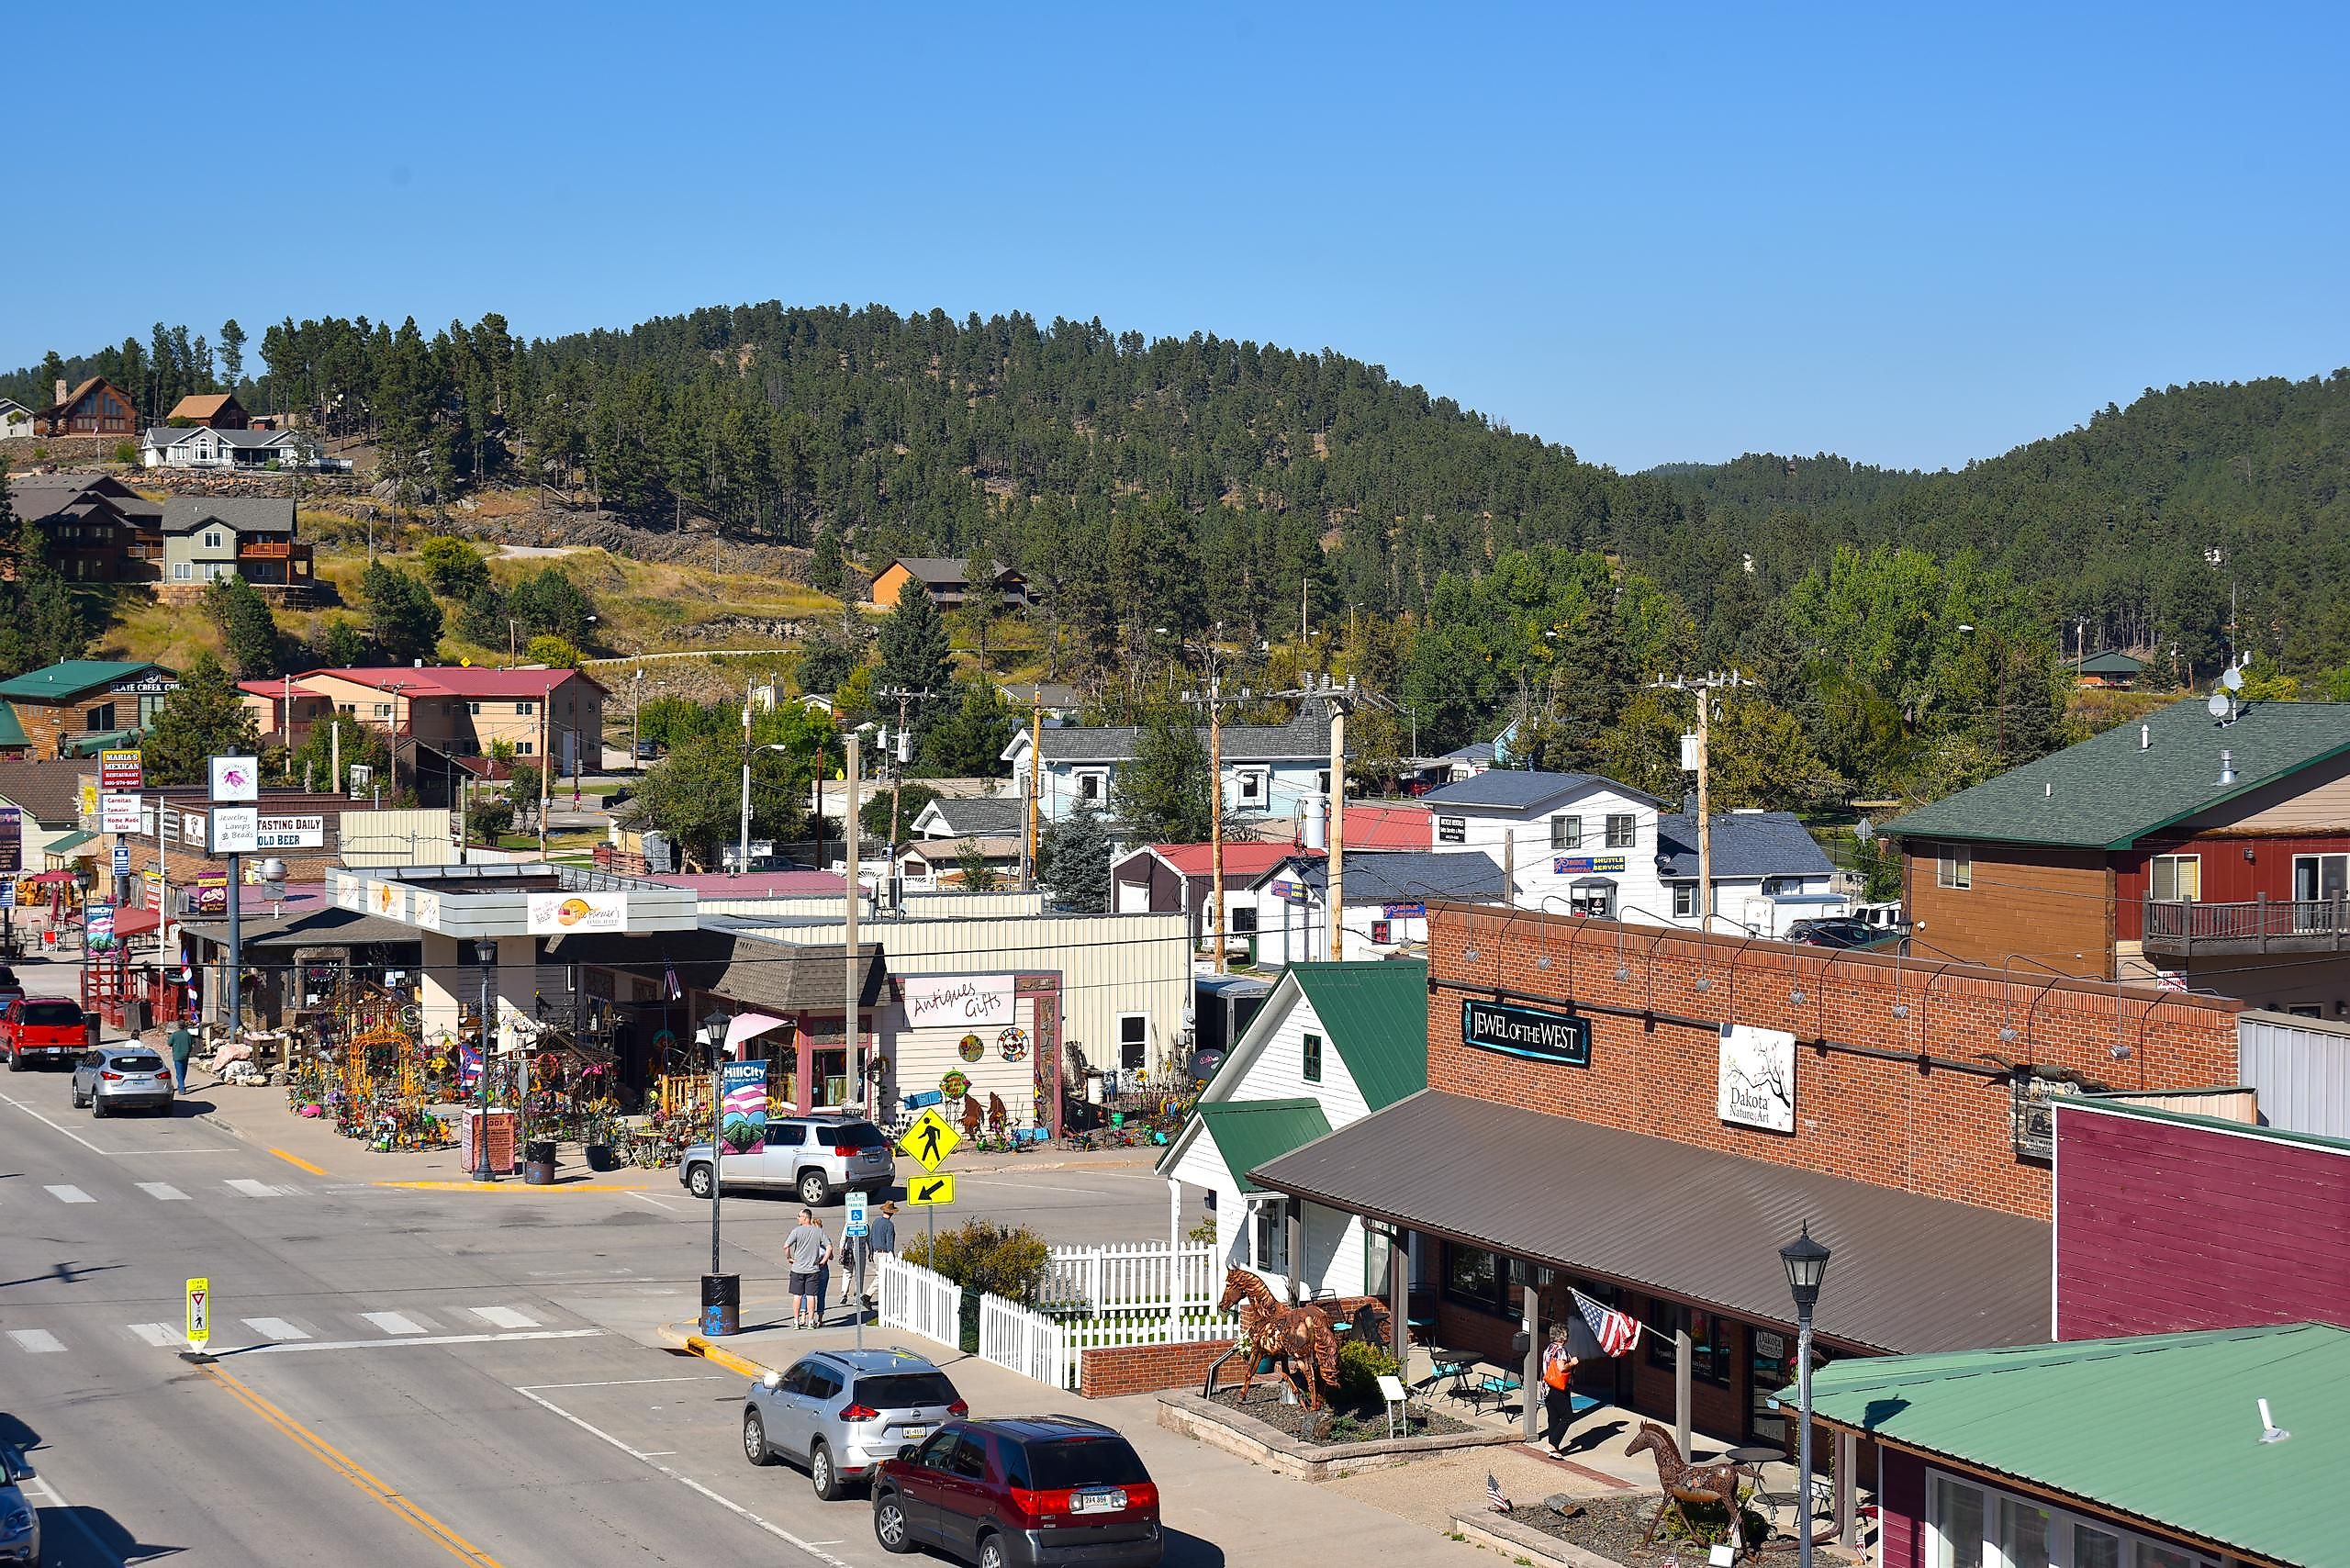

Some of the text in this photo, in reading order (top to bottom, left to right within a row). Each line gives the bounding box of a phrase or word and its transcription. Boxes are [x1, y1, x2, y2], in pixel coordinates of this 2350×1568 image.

[112, 683, 136, 691] SLATE
[137, 683, 162, 691] CREEK
[106, 753, 139, 761] MARIA'S
[218, 813, 249, 823] Jewelry
[225, 823, 251, 831] Lamps
[257, 819, 321, 831] TASTING DAILY
[257, 834, 300, 846] OLD BEER
[88, 906, 114, 914] HillCity
[914, 982, 976, 1017] Antiques
[965, 992, 1001, 1018] Gifts
[1473, 1011, 1577, 1050] JEWEL OF THE WEST
[512, 1050, 528, 1059] ELM
[723, 1065, 766, 1080] HillCity
[1730, 1087, 1770, 1110] Dakota
[1729, 1103, 1754, 1120] Nature
[1757, 1110, 1769, 1124] Art
